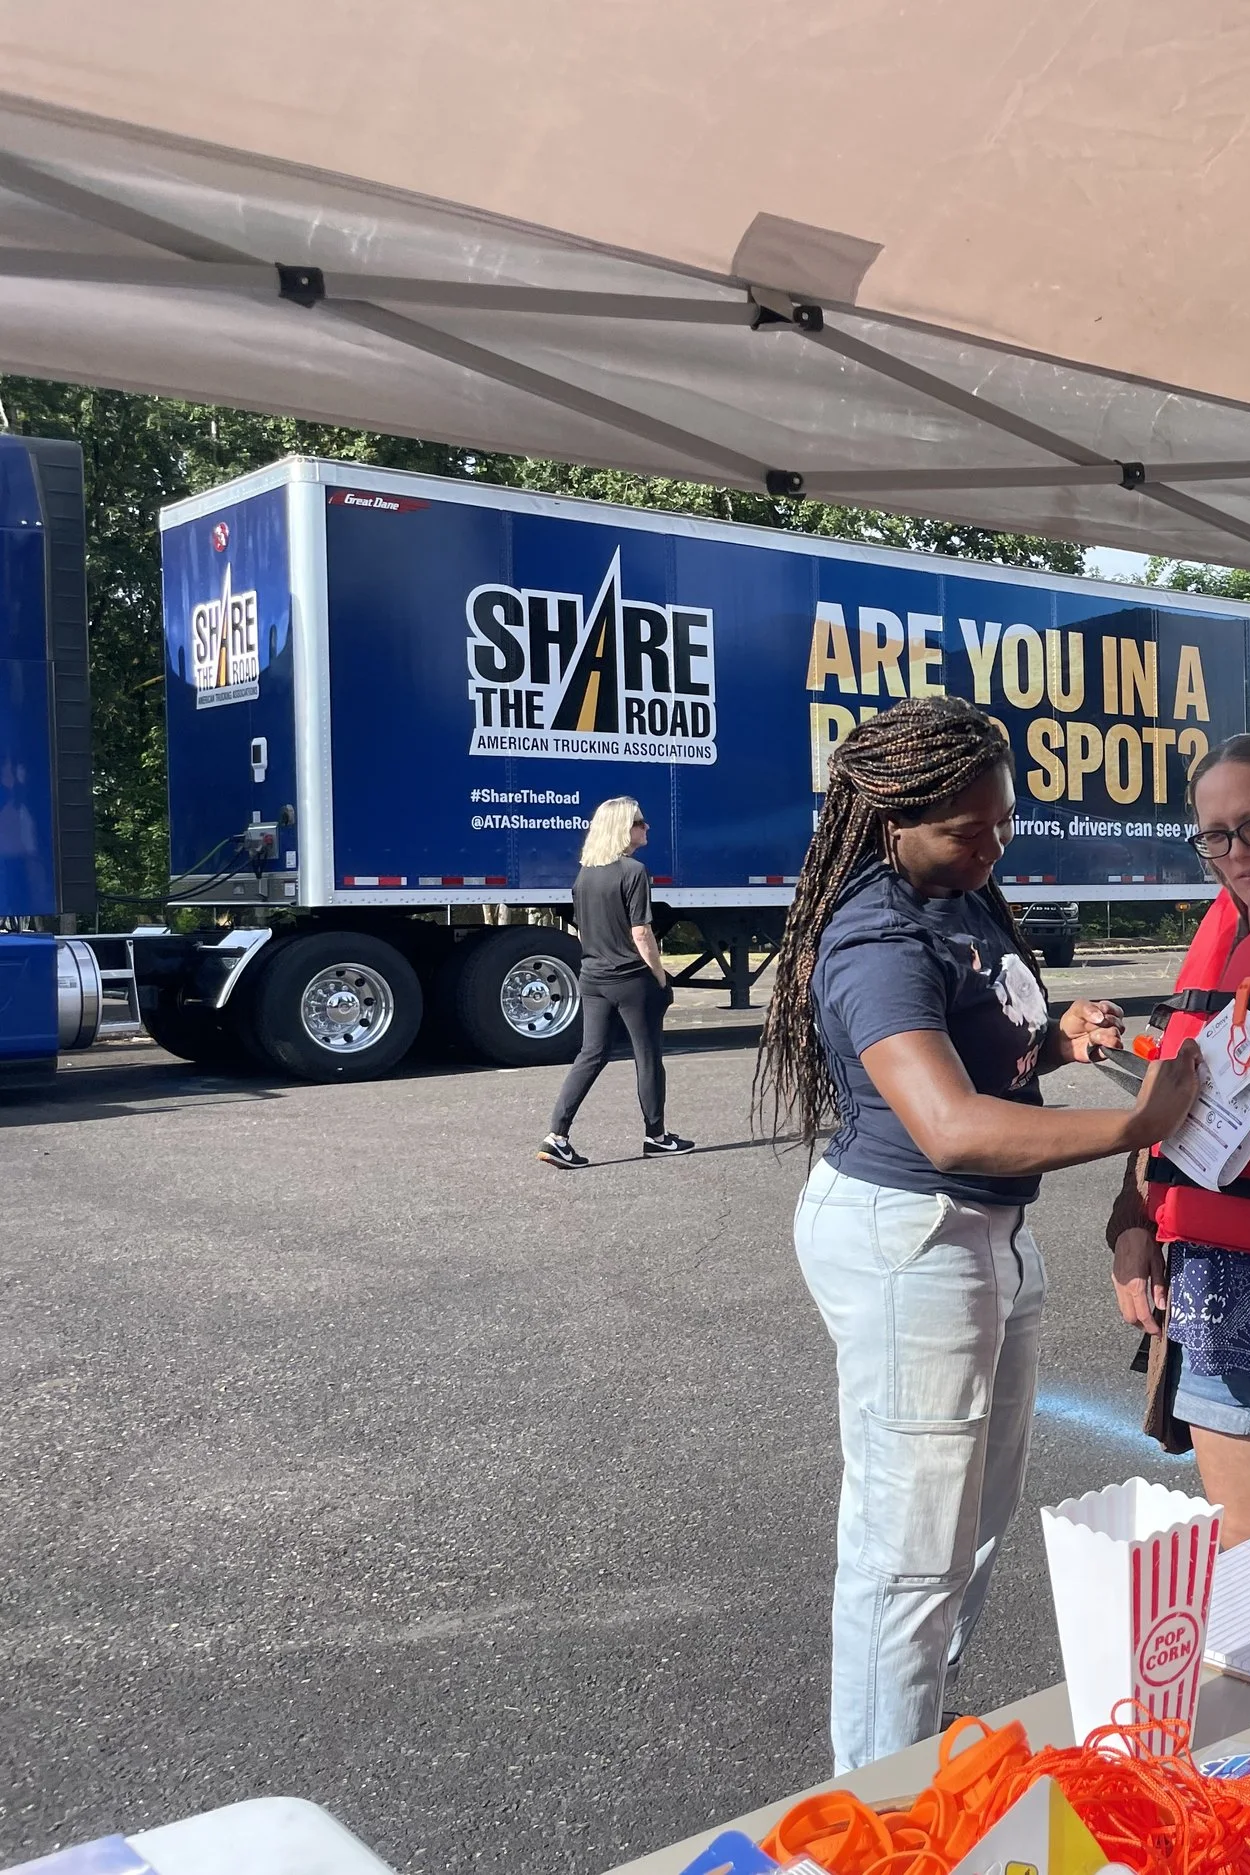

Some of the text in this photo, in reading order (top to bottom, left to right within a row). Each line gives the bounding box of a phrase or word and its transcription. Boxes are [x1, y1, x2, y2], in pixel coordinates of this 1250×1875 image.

[344, 493, 400, 511] Great Dane
[196, 588, 255, 688] SHARE
[473, 574, 709, 734] SHARE
[196, 657, 257, 692] THE ROAD
[806, 600, 1210, 721] ARE YOU IN A
[476, 687, 711, 738] THE ROAD
[477, 735, 712, 759] AMERICAN TRUCKING ASSOCIATIONS
[1027, 717, 1209, 804] SPOT?
[470, 789, 580, 805] #ShareTheRoad
[471, 815, 593, 830] @ATASharetheRo
[1015, 815, 1199, 842] irrors, drivers can see yo
[1146, 1639, 1191, 1671] CORN
[1155, 1626, 1186, 1652] POP
